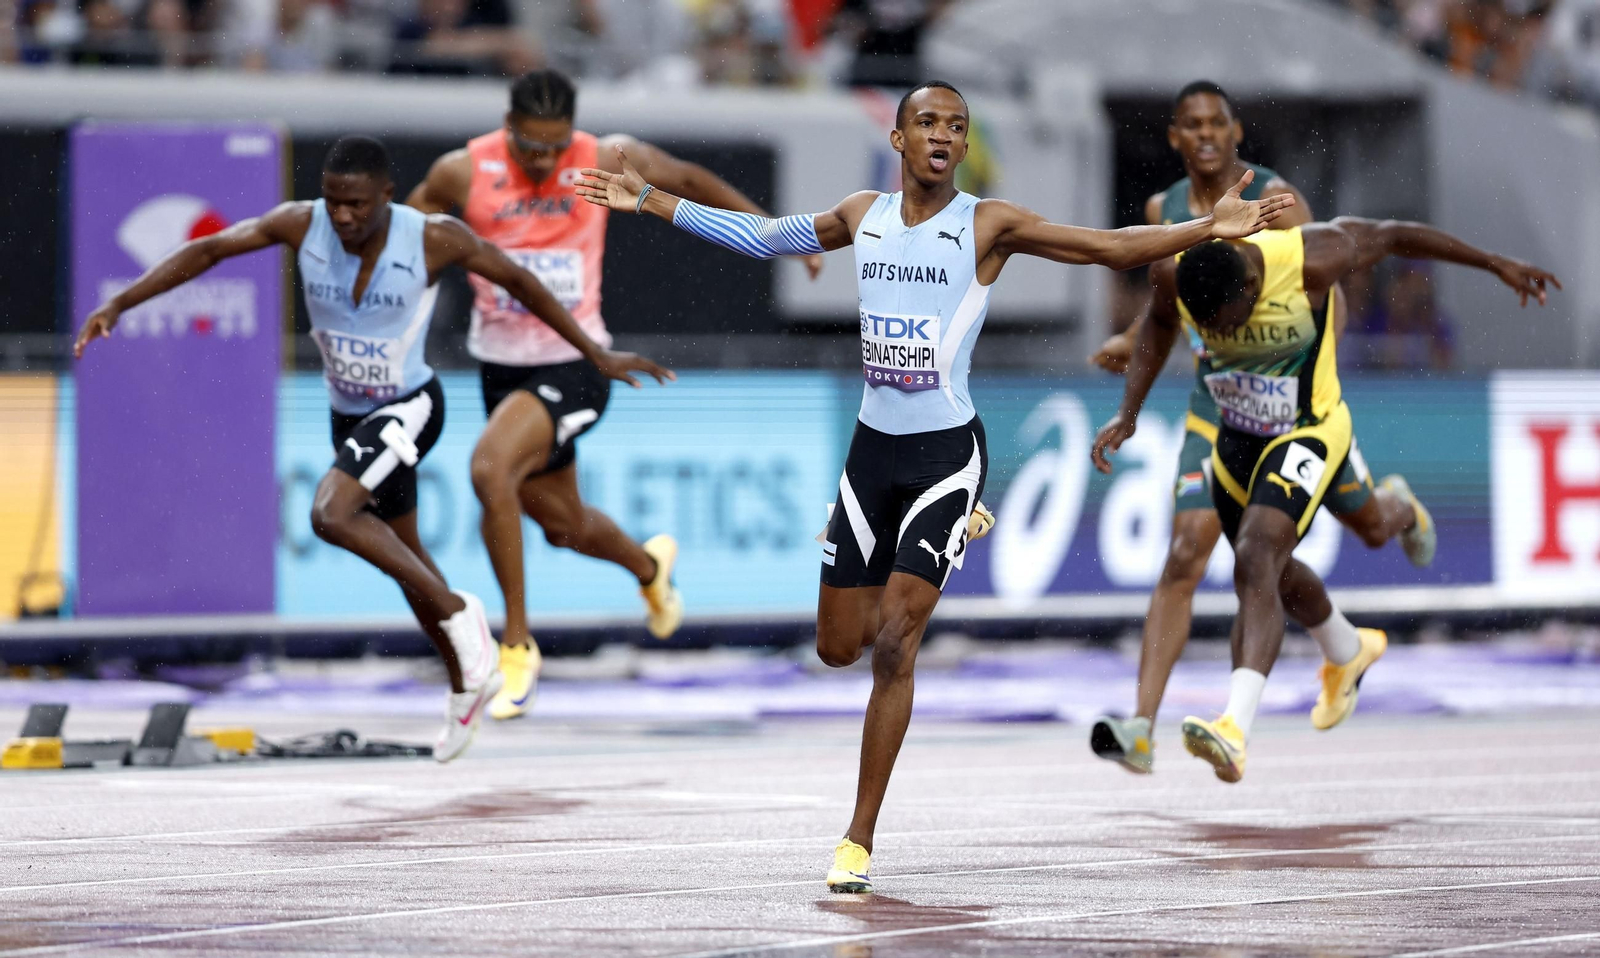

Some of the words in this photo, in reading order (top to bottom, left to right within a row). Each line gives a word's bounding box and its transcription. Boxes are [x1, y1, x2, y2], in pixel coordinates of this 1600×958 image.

[494, 196, 573, 220] JAPAN
[862, 262, 949, 286] BOTSWANA
[868, 314, 931, 341] TDK
[331, 336, 389, 359] TDK
[1231, 372, 1288, 396] TDK
[1213, 385, 1292, 419] McDONALD
[1297, 459, 1313, 481] 6
[953, 526, 967, 558] 5
